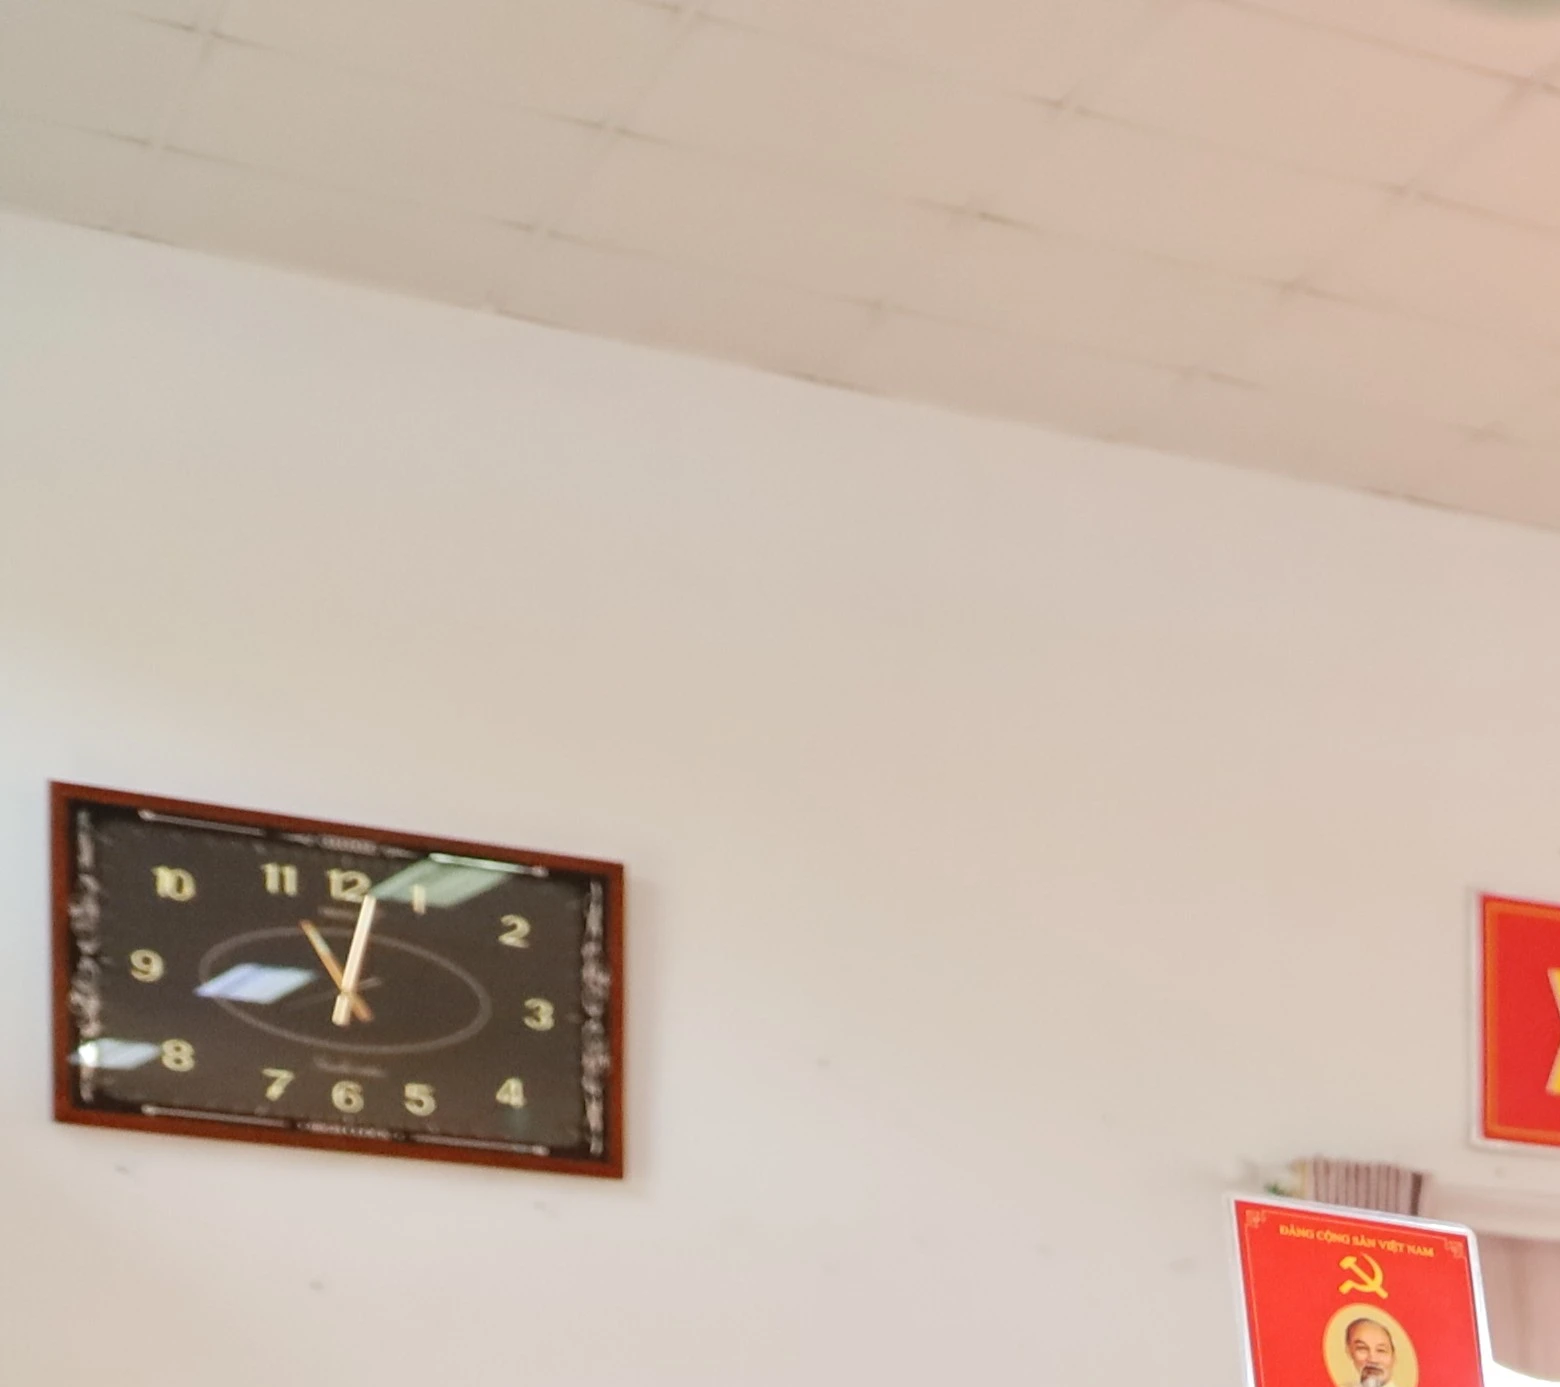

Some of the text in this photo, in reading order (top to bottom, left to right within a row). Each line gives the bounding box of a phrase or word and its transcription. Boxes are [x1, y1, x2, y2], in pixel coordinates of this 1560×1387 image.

[152, 866, 196, 901] 10
[263, 863, 298, 896] 11
[326, 868, 372, 903] 12
[412, 883, 427, 916] 1
[499, 914, 531, 949] 2
[129, 949, 164, 983] 9
[523, 998, 555, 1032] 3
[161, 1039, 196, 1072] 8
[262, 1068, 295, 1101] 7
[331, 1081, 364, 1113] 6
[403, 1083, 437, 1117] 5
[496, 1078, 525, 1110] 4
[1279, 1224, 1315, 1240] ĐẢNG
[1407, 1245, 1434, 1257] NAM
